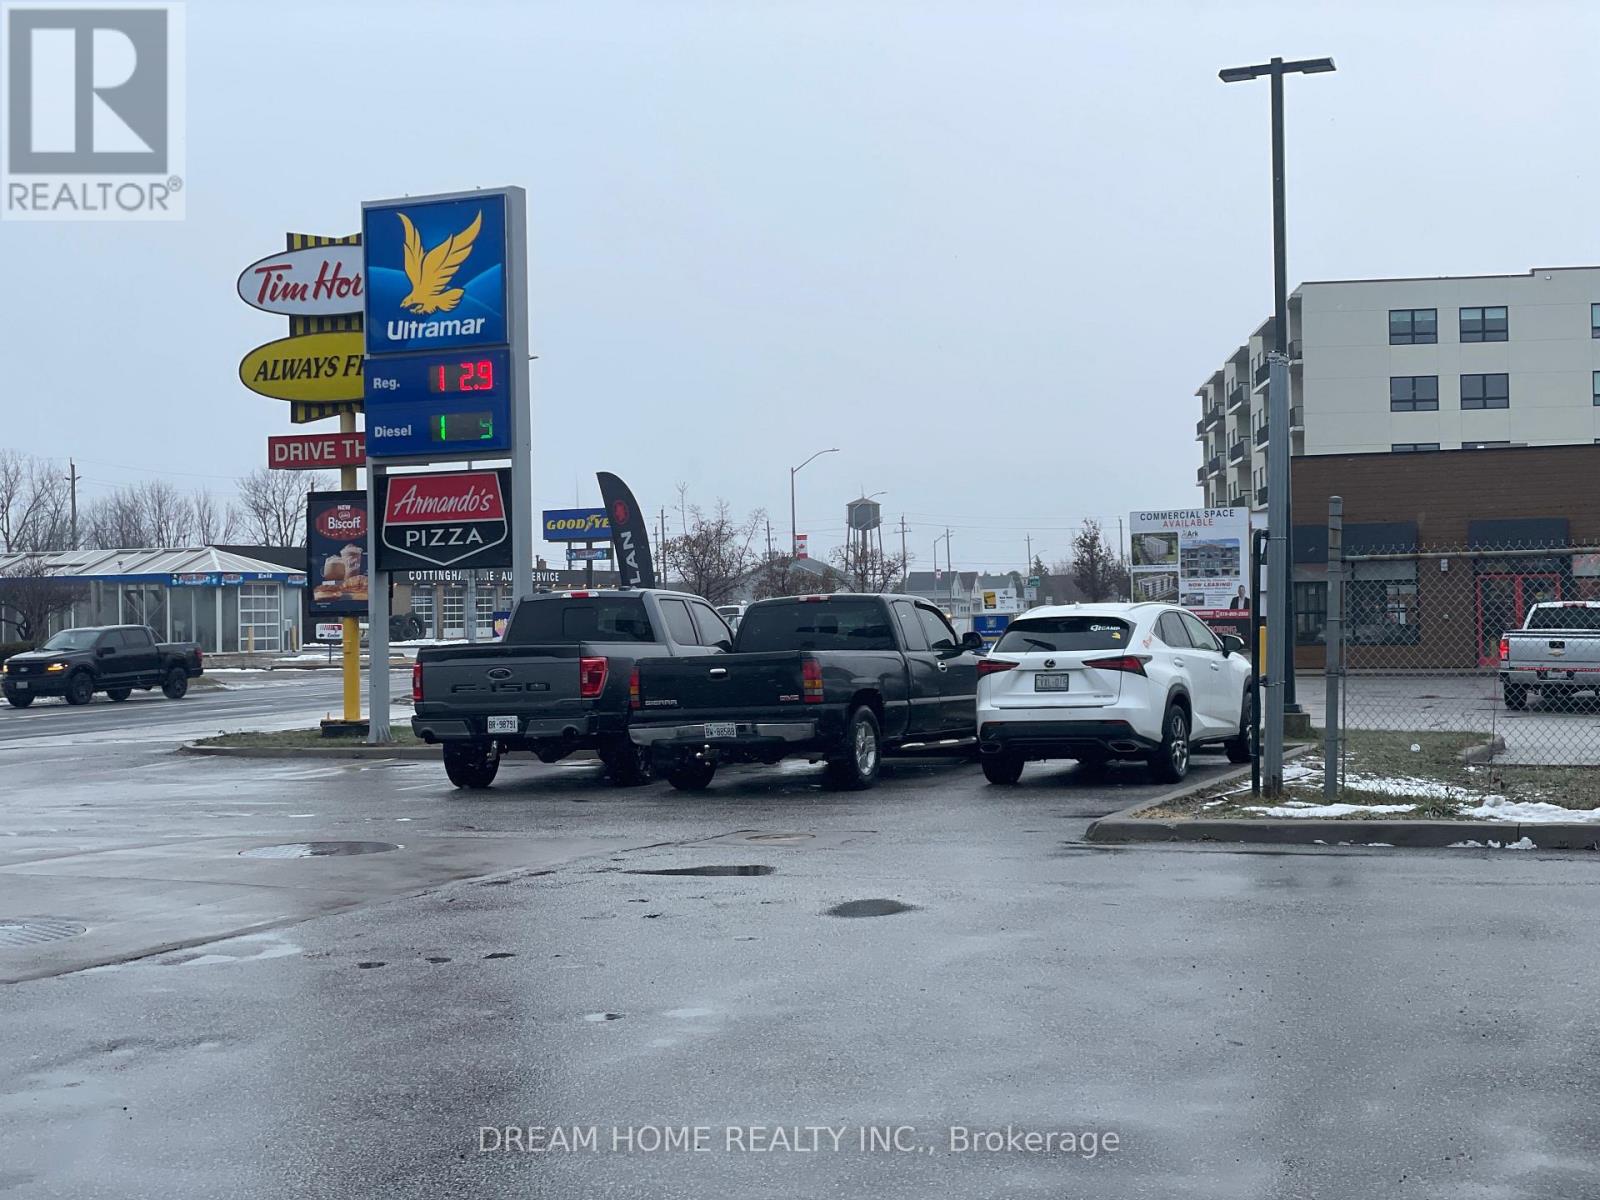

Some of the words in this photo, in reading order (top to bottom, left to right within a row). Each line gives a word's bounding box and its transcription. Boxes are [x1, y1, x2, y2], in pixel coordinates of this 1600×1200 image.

[255, 264, 309, 305] Tim
[312, 260, 364, 300] Hor
[387, 317, 485, 340] Ultramar
[253, 355, 340, 381] ALWAYS
[373, 377, 400, 390] Reg.
[374, 424, 412, 438] Diesel
[274, 441, 336, 462] DRIVE
[342, 439, 365, 458] TH
[393, 484, 494, 516] Armando's
[328, 516, 361, 529] Biscoff
[1140, 511, 1200, 521] COMMERCIAL
[1204, 509, 1235, 518] SPACE
[546, 516, 609, 531] GOODYE
[1163, 518, 1214, 528] AVAILABLE
[405, 527, 484, 547] PIZZA
[620, 531, 641, 584] LAN
[408, 570, 462, 581] COTTINGHA
[501, 571, 513, 581] AU
[532, 573, 559, 583] ERVICE
[451, 682, 550, 693] F-150
